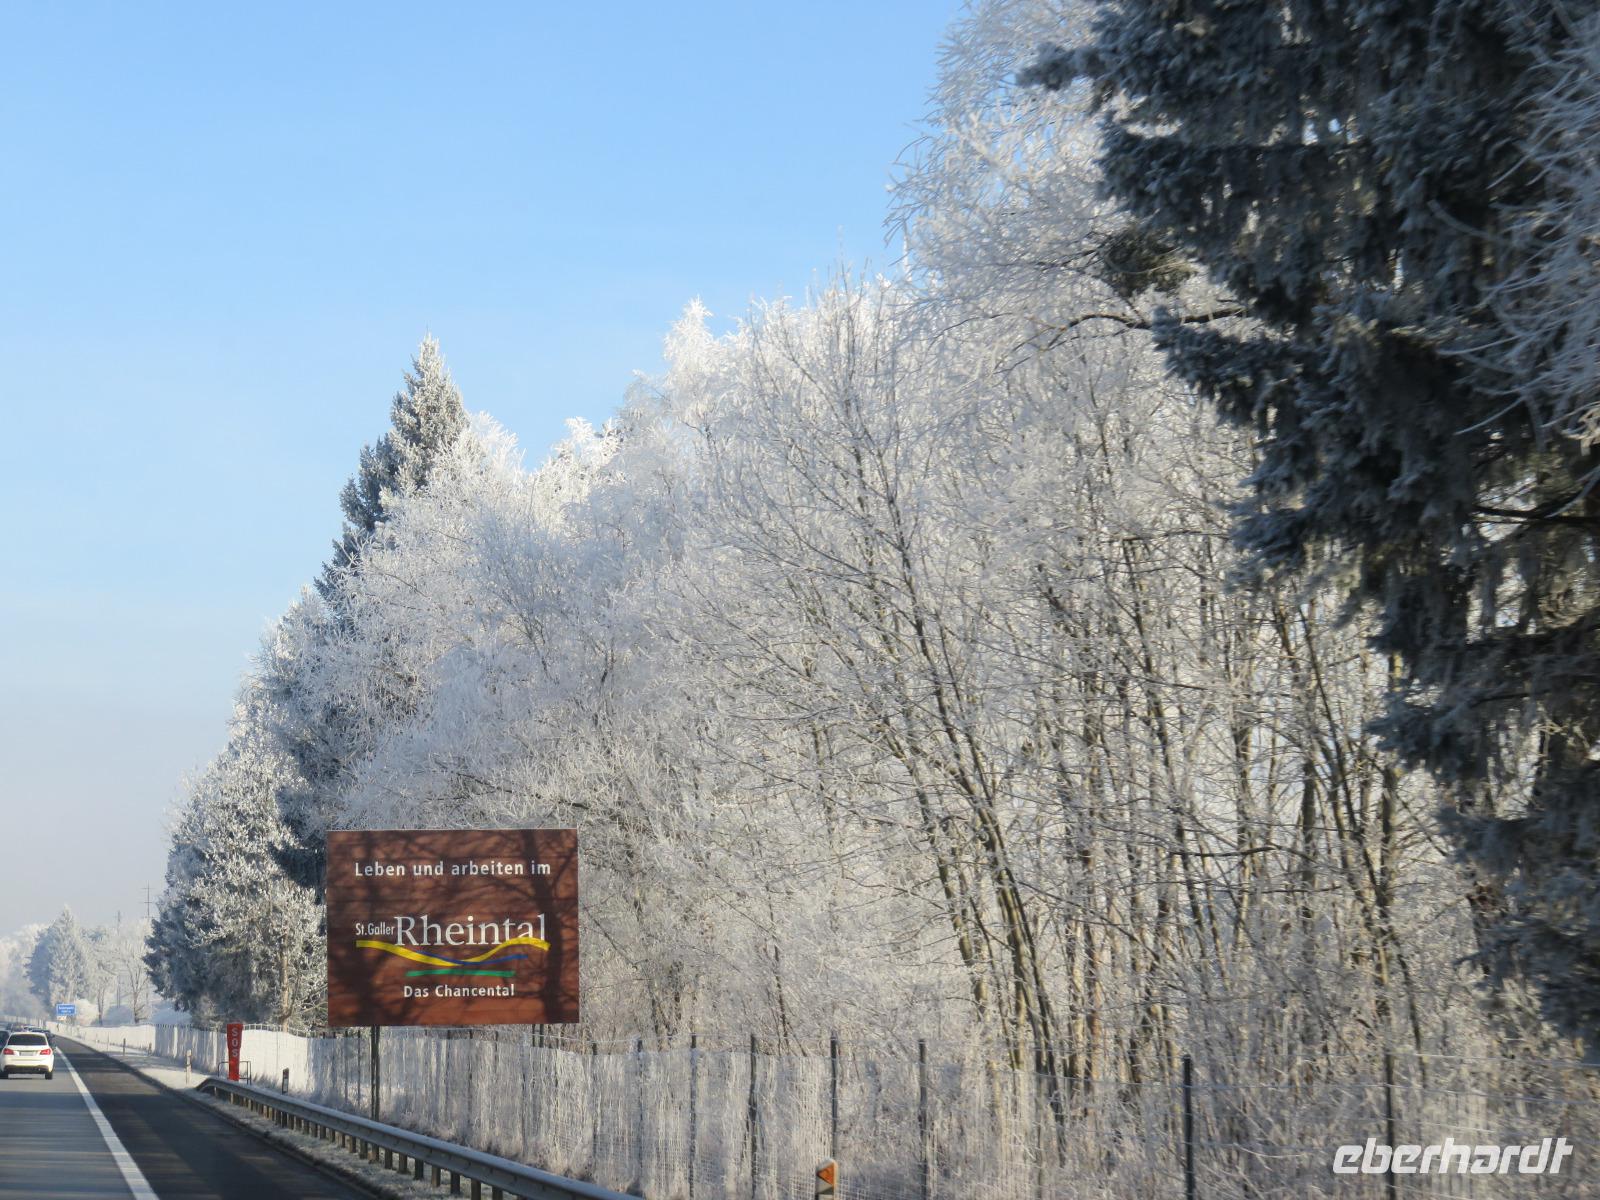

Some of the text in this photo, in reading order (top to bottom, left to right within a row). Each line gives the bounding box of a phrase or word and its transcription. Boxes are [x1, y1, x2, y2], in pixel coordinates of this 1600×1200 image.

[355, 860, 551, 877] Leben und arbeiten im
[394, 914, 546, 946] Rheintal
[403, 983, 515, 998] Das Chancental
[231, 1027, 239, 1057] SOS
